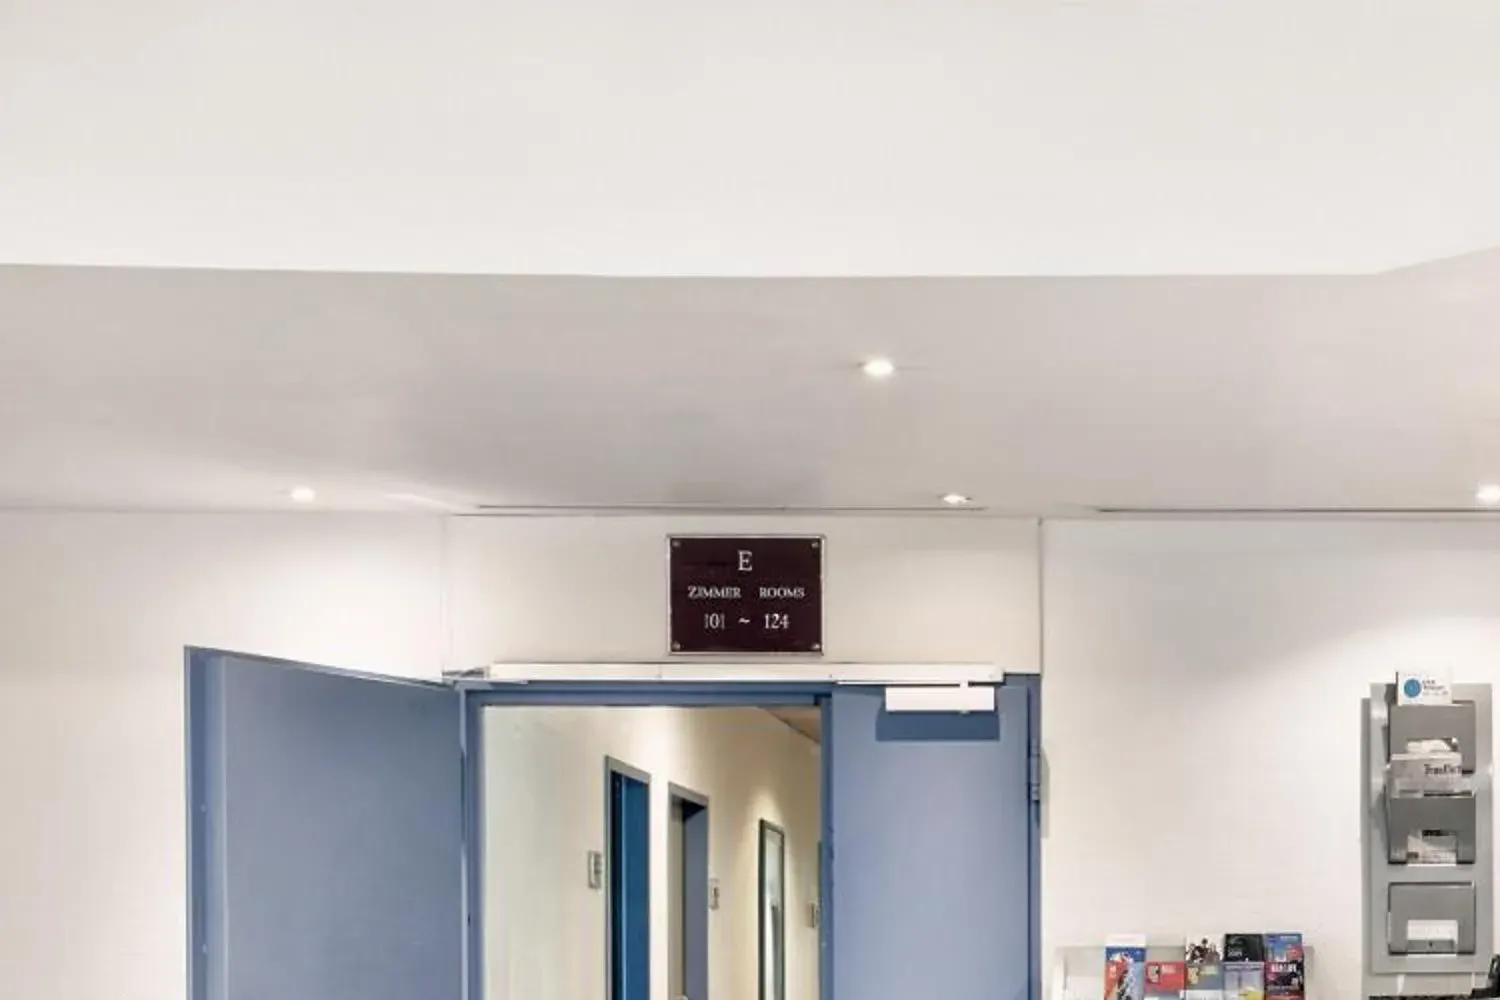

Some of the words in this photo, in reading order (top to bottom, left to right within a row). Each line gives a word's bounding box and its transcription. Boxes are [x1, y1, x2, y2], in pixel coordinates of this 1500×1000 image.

[737, 550, 753, 572] E
[687, 585, 742, 599] ZIMMER
[758, 585, 805, 599] ROOMS
[704, 613, 726, 629] 101
[764, 613, 790, 629] 124
